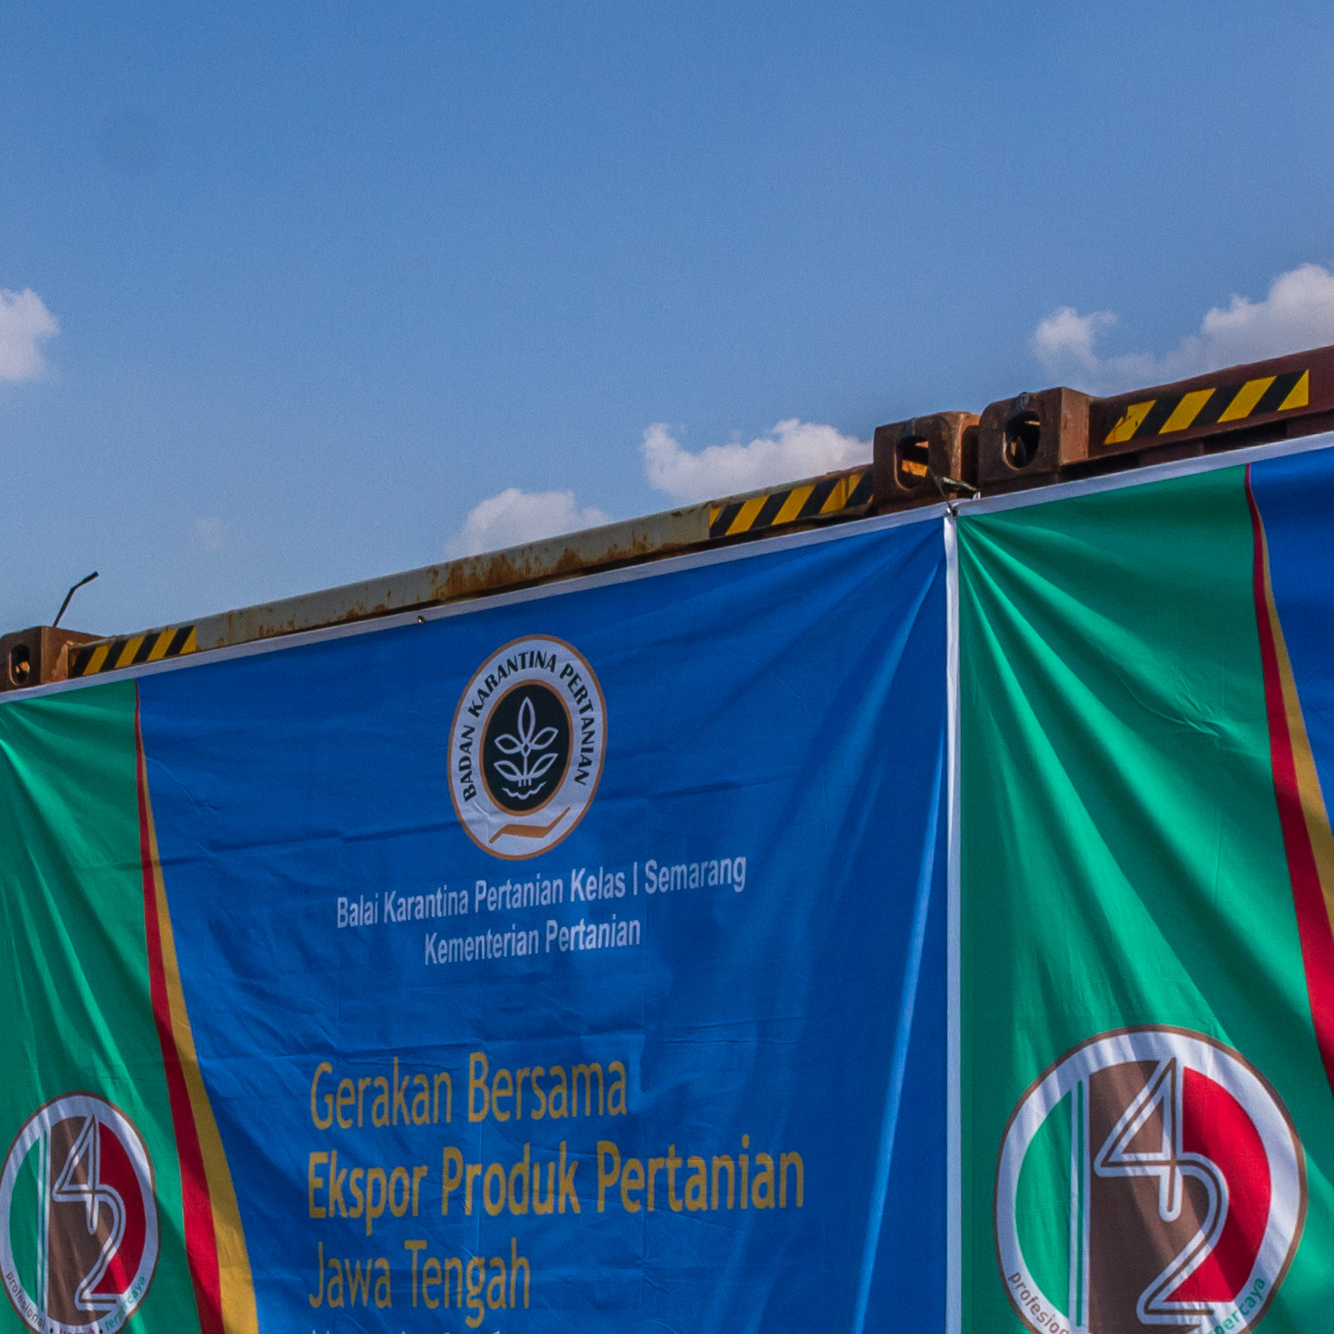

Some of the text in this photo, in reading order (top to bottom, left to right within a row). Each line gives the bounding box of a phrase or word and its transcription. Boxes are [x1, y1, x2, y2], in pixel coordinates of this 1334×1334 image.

[460, 650, 593, 802] BADAN KARANTINA PERTANIAN
[337, 891, 378, 928] Balai
[383, 884, 469, 924] Karantina
[475, 872, 563, 914] Pertanian
[570, 867, 626, 903] Kelas
[645, 856, 747, 894] Semarang
[425, 916, 641, 966] Kementerian Pertanian
[310, 1050, 627, 1131] Gerakan Bersama
[308, 1133, 805, 1236] Ekspor Produk Pertanian
[309, 1237, 531, 1328] Jawa Tengah
